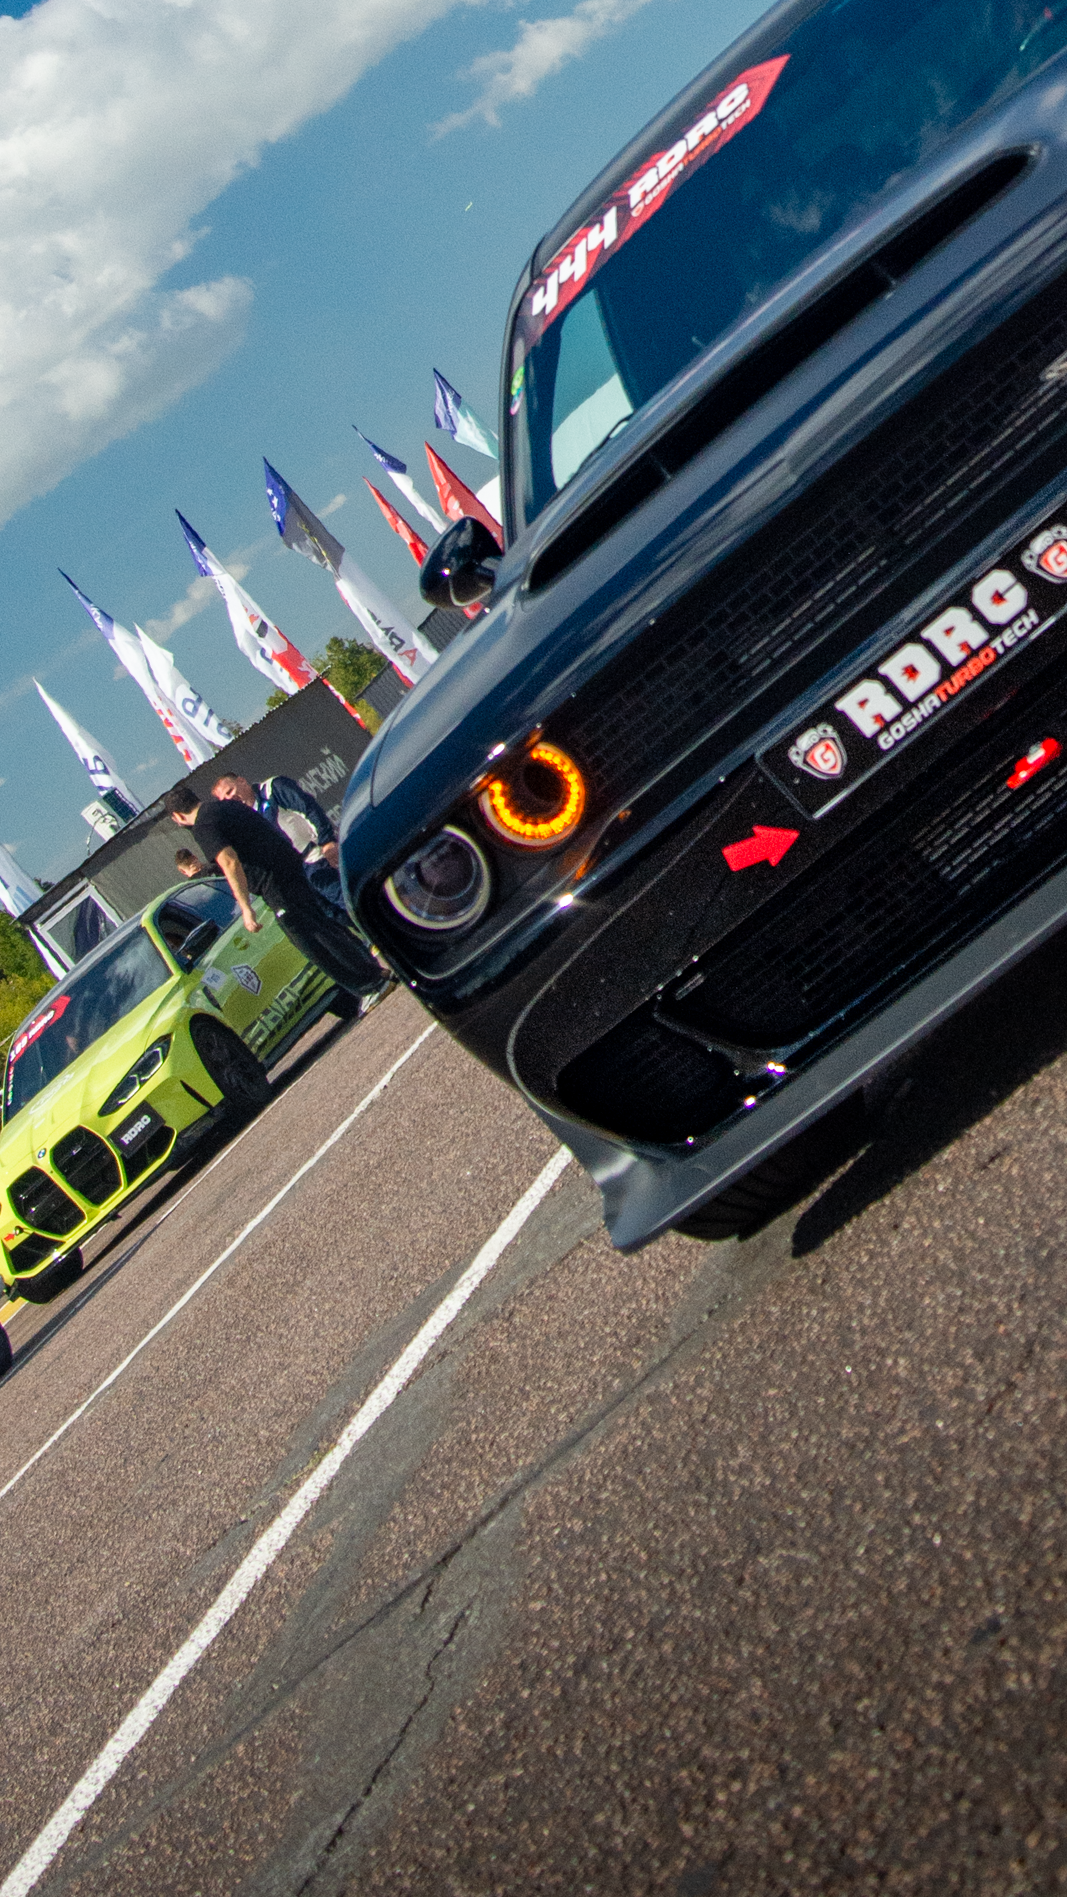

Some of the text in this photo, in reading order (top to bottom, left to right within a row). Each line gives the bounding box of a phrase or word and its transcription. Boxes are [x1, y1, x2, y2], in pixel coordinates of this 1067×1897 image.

[532, 206, 618, 316] 444
[834, 568, 1028, 739] RDRC
[877, 608, 1040, 751] GOSHATURBOTECH
[121, 1114, 151, 1146] RDRC
